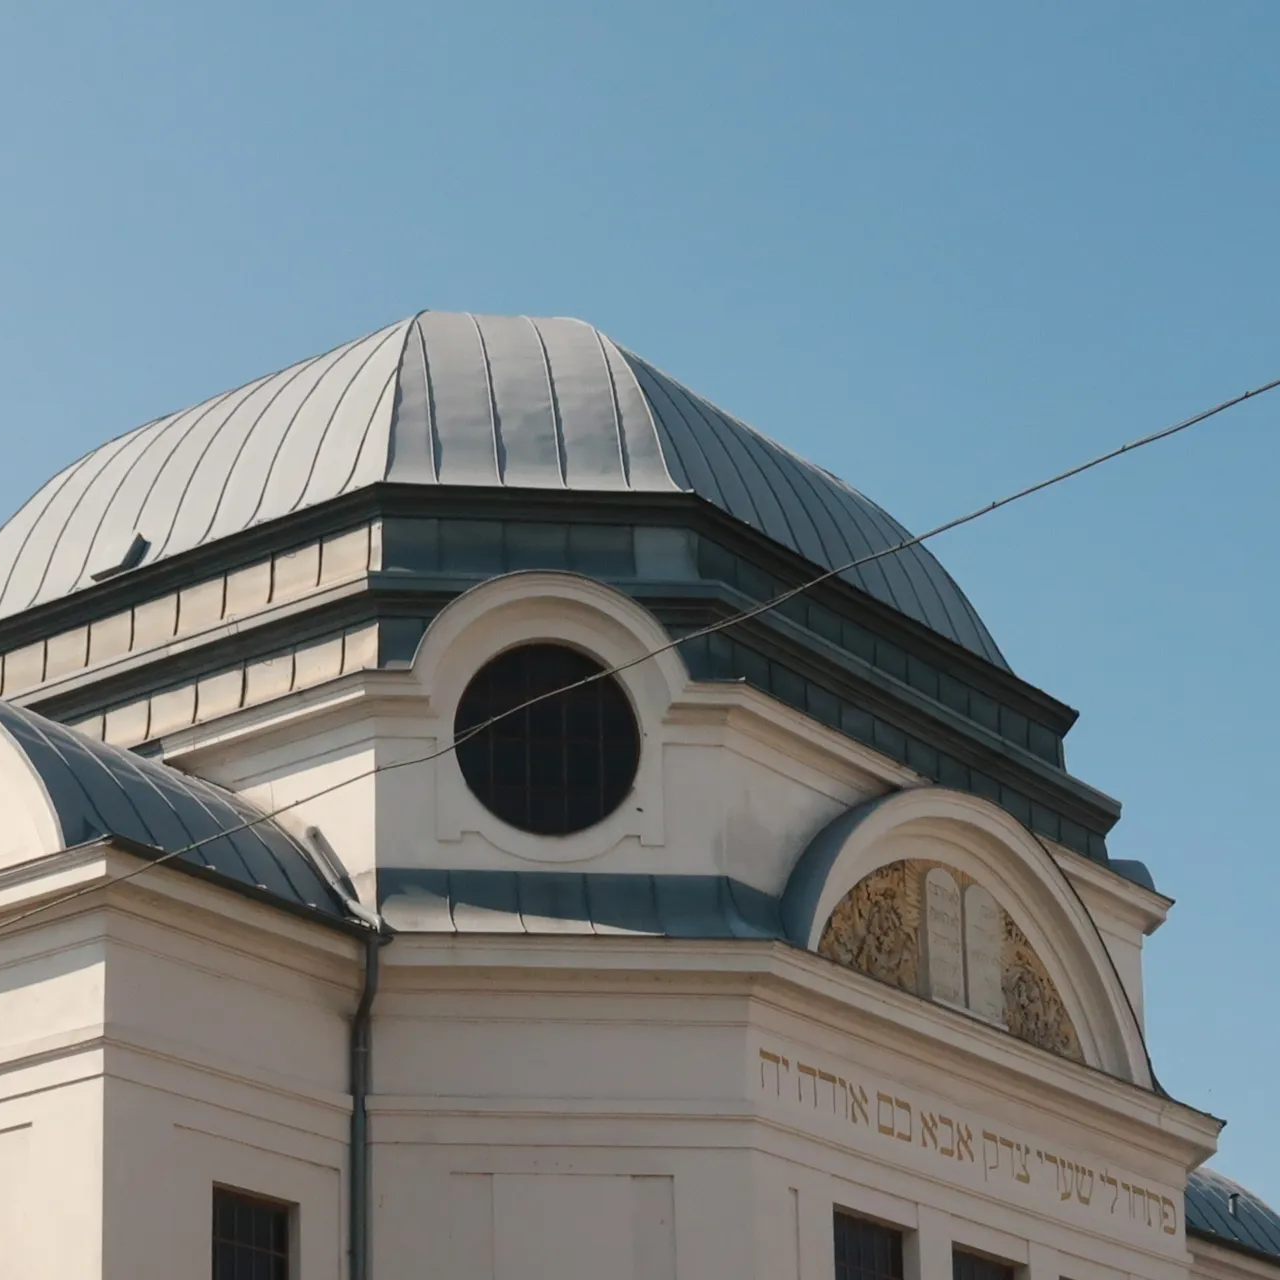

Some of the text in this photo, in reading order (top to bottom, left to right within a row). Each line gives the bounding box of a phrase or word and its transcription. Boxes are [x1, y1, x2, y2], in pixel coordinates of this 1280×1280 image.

[759, 1047, 790, 1097] יה
[1036, 1149, 1095, 1206] שערי
[1100, 1168, 1118, 1214] לי
[1121, 1181, 1177, 1235] פתחו
